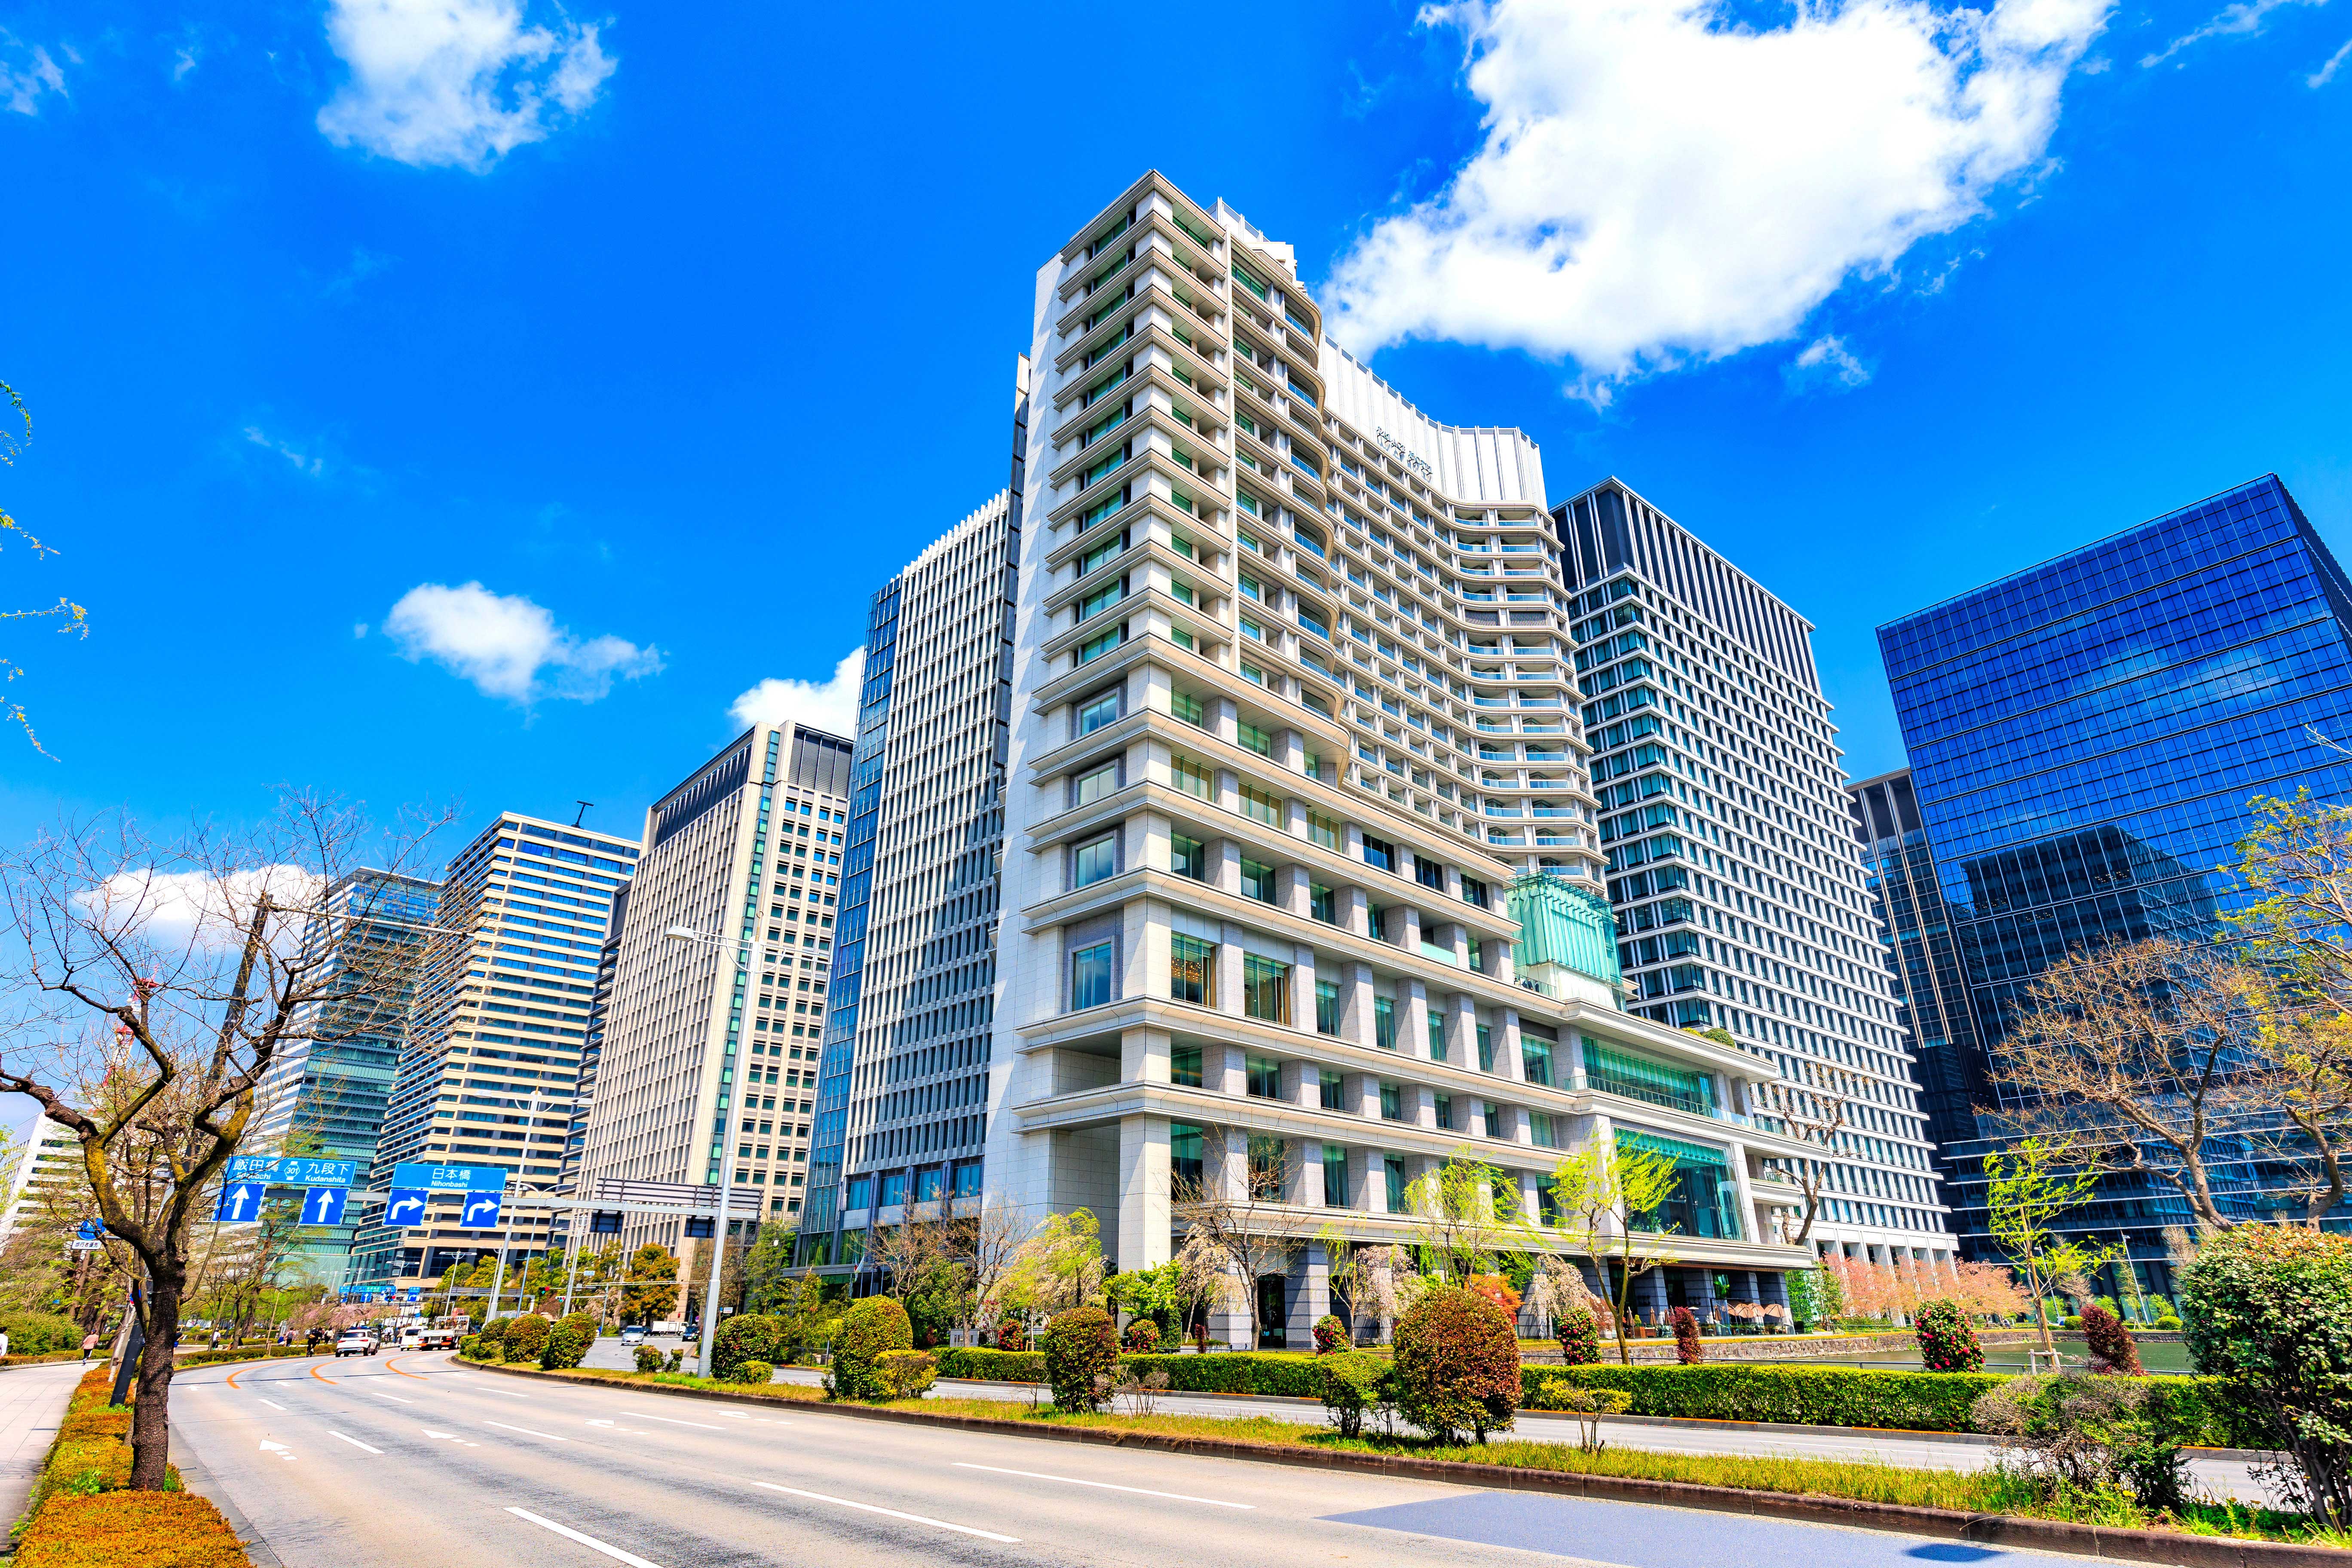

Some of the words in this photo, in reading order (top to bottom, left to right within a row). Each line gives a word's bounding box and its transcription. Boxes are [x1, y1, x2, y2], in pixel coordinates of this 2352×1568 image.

[233, 1159, 280, 1172] 飯田橋
[306, 1162, 351, 1175] 九段下
[305, 1175, 346, 1183] Kudanshita
[432, 1168, 472, 1180] 日本橋
